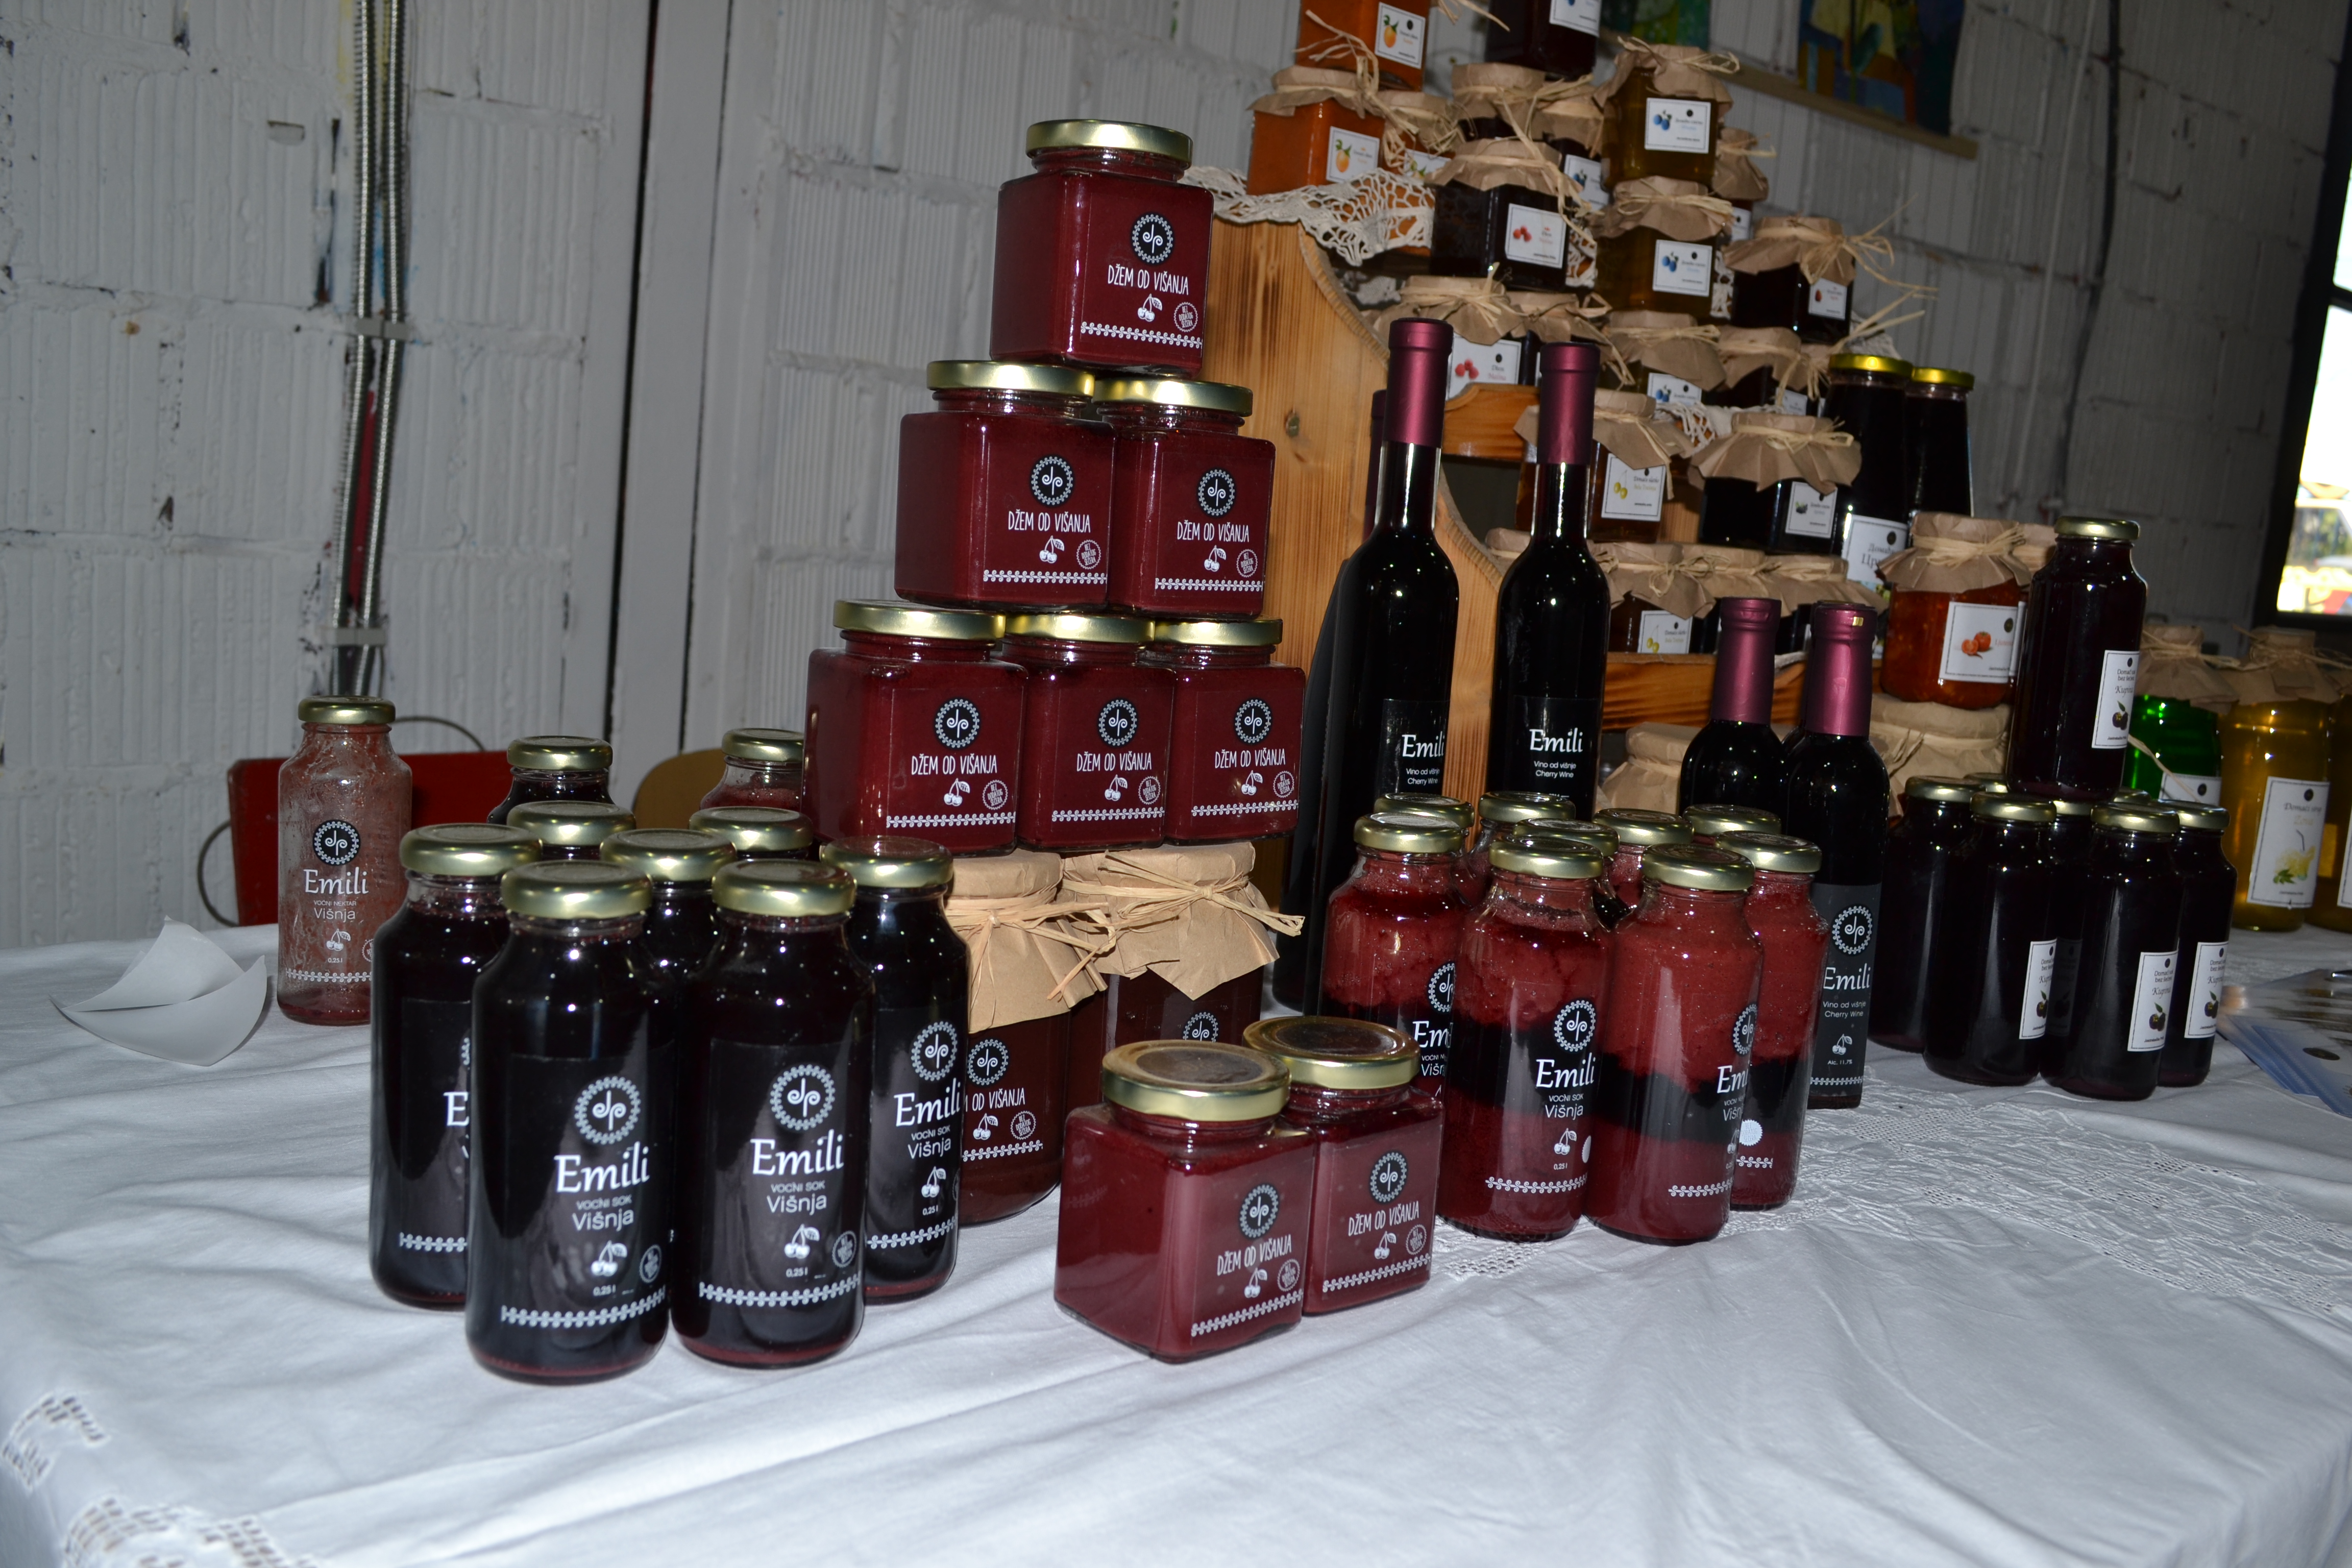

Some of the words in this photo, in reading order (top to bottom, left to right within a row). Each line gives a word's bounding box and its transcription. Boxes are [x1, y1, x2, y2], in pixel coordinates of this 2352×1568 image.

[1108, 263, 1134, 287] DŽEM
[1137, 270, 1150, 289] OD
[1154, 271, 1189, 296] VIŠANJA
[1008, 509, 1034, 530] DŽEM
[1038, 512, 1050, 531] OD
[1055, 511, 1091, 533] VIŠANJA
[1177, 520, 1199, 541] DŽEM
[1204, 523, 1215, 541] OD
[1218, 522, 1250, 542] VIŠANJA
[1402, 731, 1445, 757] Emili
[1529, 727, 1583, 752] Emili
[912, 753, 938, 775] DŽEM
[943, 755, 955, 775] OD
[960, 753, 997, 774] VIŠANJA
[1076, 751, 1100, 772] DŽEM
[1104, 753, 1116, 771] OD
[1119, 751, 1152, 771] VIŠANJA
[1215, 749, 1237, 769] DŽEM
[1240, 750, 1251, 767] OD
[1255, 747, 1286, 767] VIŠANJA
[1408, 777, 1427, 786] Cherry
[1535, 770, 1558, 778] Cherry
[304, 867, 369, 894] Emili
[314, 908, 355, 923] Višnja
[1823, 963, 1871, 990] Emili
[1825, 1011, 1849, 1019] Cherry
[1851, 1000, 1866, 1009] višnje
[1536, 1052, 1596, 1088] Emili
[894, 1077, 961, 1127] Emili
[972, 1093, 985, 1111] OD
[989, 1087, 1025, 1109] VIŠANJA
[1572, 1093, 1584, 1101] SOK
[1545, 1103, 1583, 1120] Višnja
[937, 1124, 950, 1136] SOK
[750, 1129, 844, 1175] Emili
[908, 1137, 951, 1159] Višnja
[554, 1141, 650, 1193] Emili
[805, 1180, 825, 1191] SOK
[611, 1194, 632, 1207] SOK
[767, 1193, 827, 1215] Višnja
[572, 1208, 634, 1232] Višnja
[1348, 1213, 1371, 1237] DŽEM
[1375, 1210, 1386, 1230] OD
[1389, 1200, 1419, 1226] VIŠANJA
[1217, 1250, 1241, 1276] DŽEM
[1244, 1245, 1256, 1267] OD
[1260, 1234, 1292, 1262] VIŠANJA
